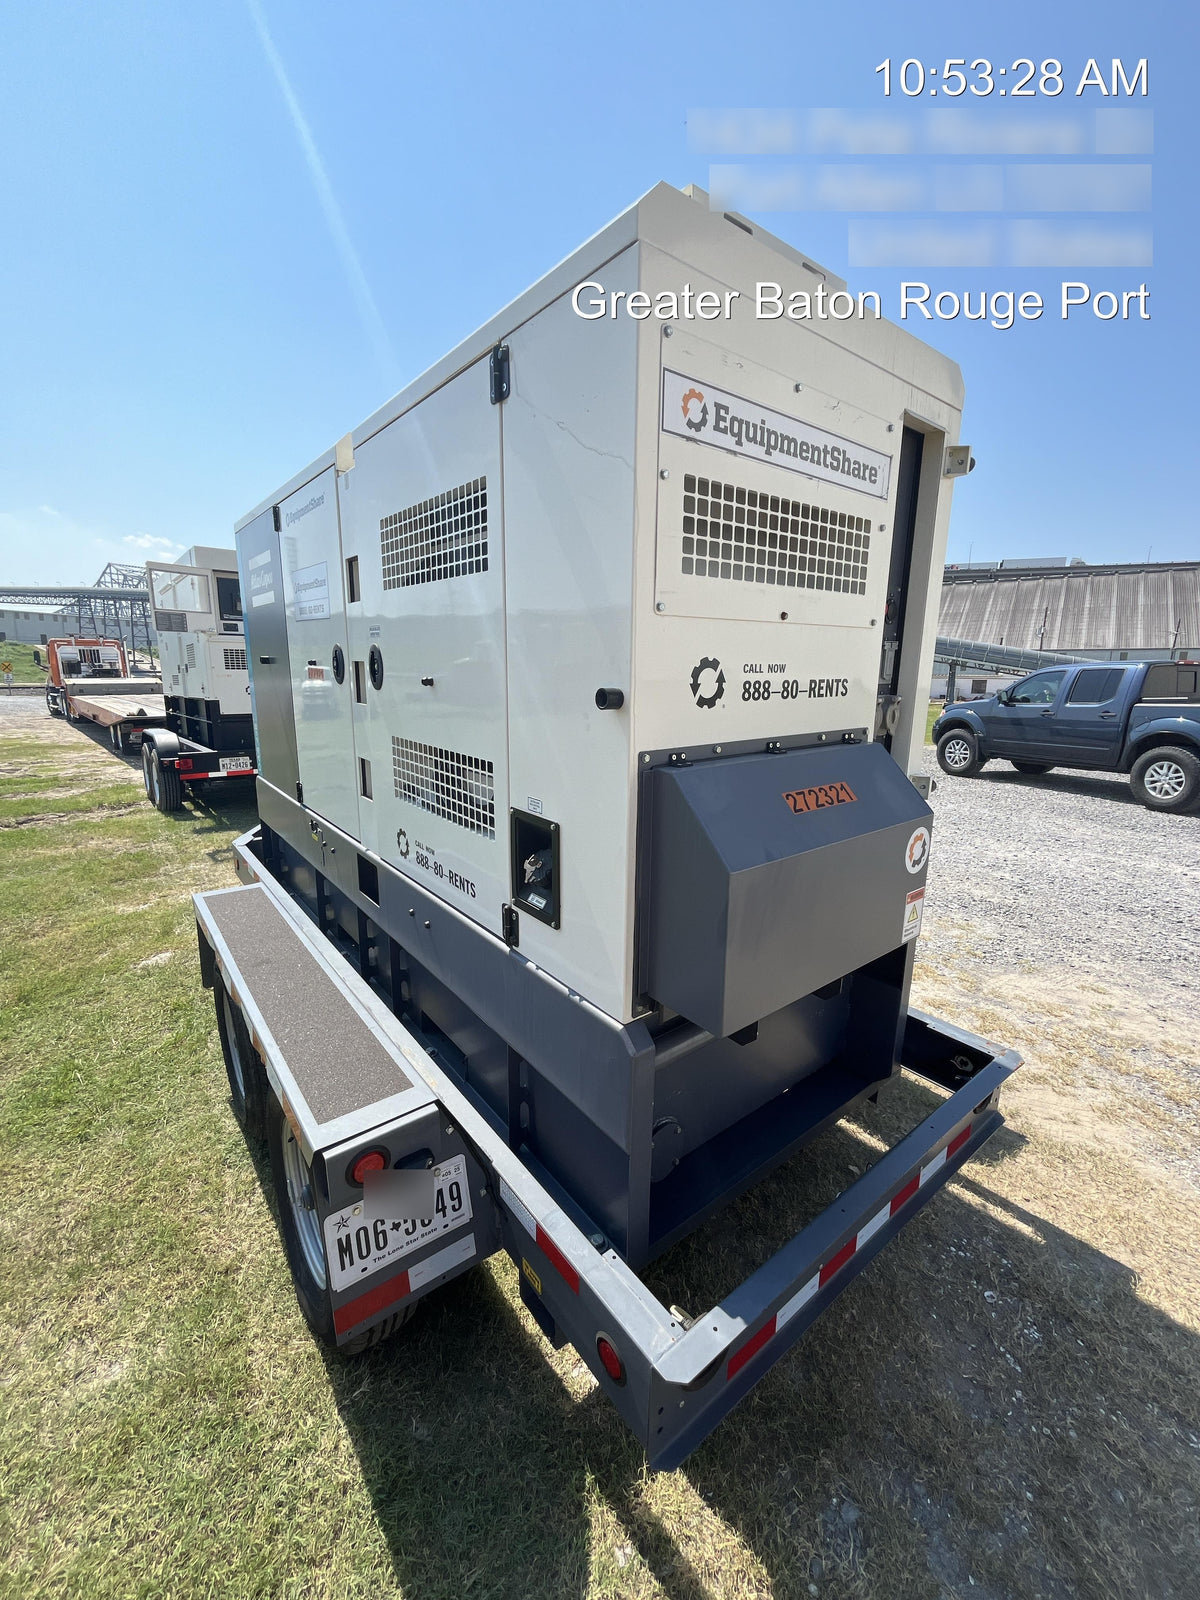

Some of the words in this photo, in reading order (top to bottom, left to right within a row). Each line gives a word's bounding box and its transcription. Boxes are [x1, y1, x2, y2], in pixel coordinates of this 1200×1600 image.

[713, 401, 878, 485] EquipmentShare
[743, 663, 764, 674] CALL
[767, 663, 787, 674] NOW
[741, 678, 849, 702] 888-80-RENTS
[785, 782, 854, 814] 272321
[415, 839, 425, 851] CALL
[425, 845, 435, 856] NOW
[415, 850, 476, 898] 888-80-RENTS
[372, 1253, 386, 1263] The
[387, 1245, 404, 1256] Lone
[405, 1236, 420, 1247] Star
[421, 1227, 438, 1239] State
